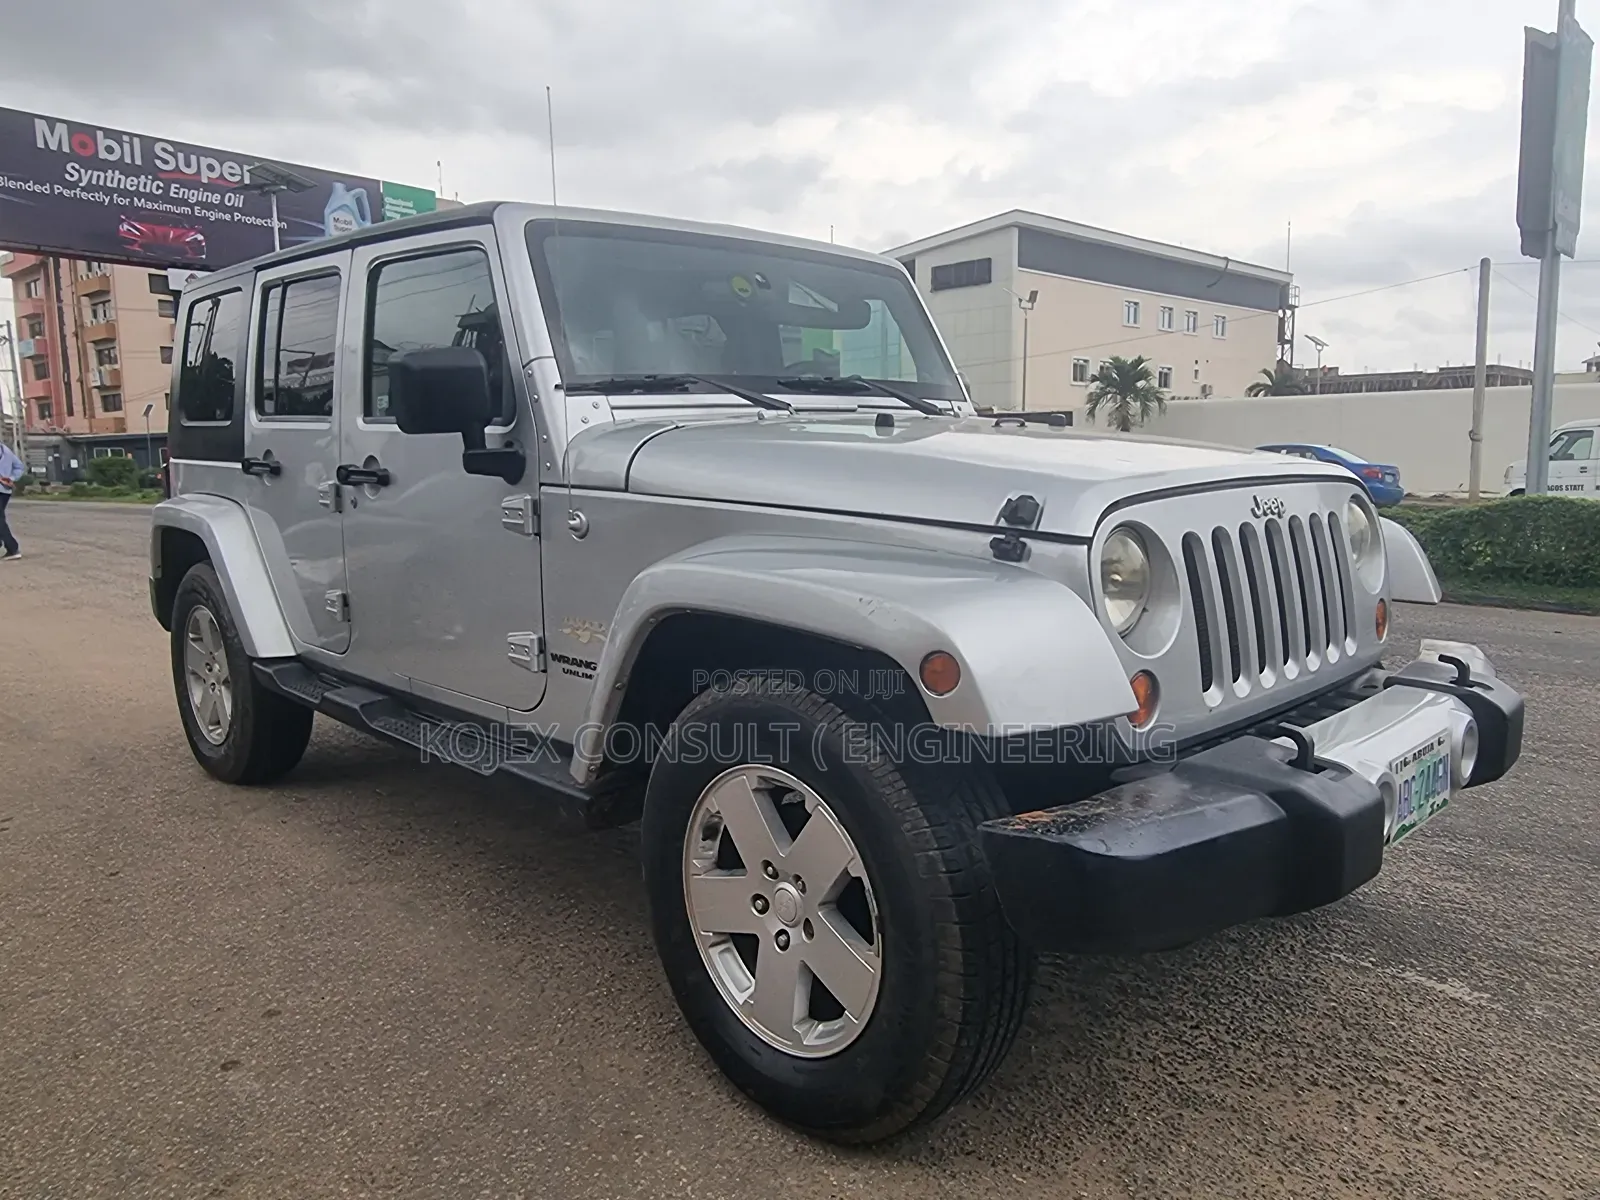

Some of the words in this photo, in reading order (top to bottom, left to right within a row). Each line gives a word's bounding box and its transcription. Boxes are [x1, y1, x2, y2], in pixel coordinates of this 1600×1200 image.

[34, 117, 143, 166] Mobil
[153, 141, 252, 184] Super
[64, 161, 165, 196] Synthetic
[169, 183, 221, 204] Engine
[224, 192, 245, 208] Oil
[53, 184, 111, 206] Perfectly
[113, 193, 131, 205] for
[133, 196, 192, 215] Maximum
[194, 206, 232, 221] Engine
[1564, 484, 1585, 492] STATE
[1250, 494, 1286, 519] Jeep
[550, 652, 598, 672] WRANG
